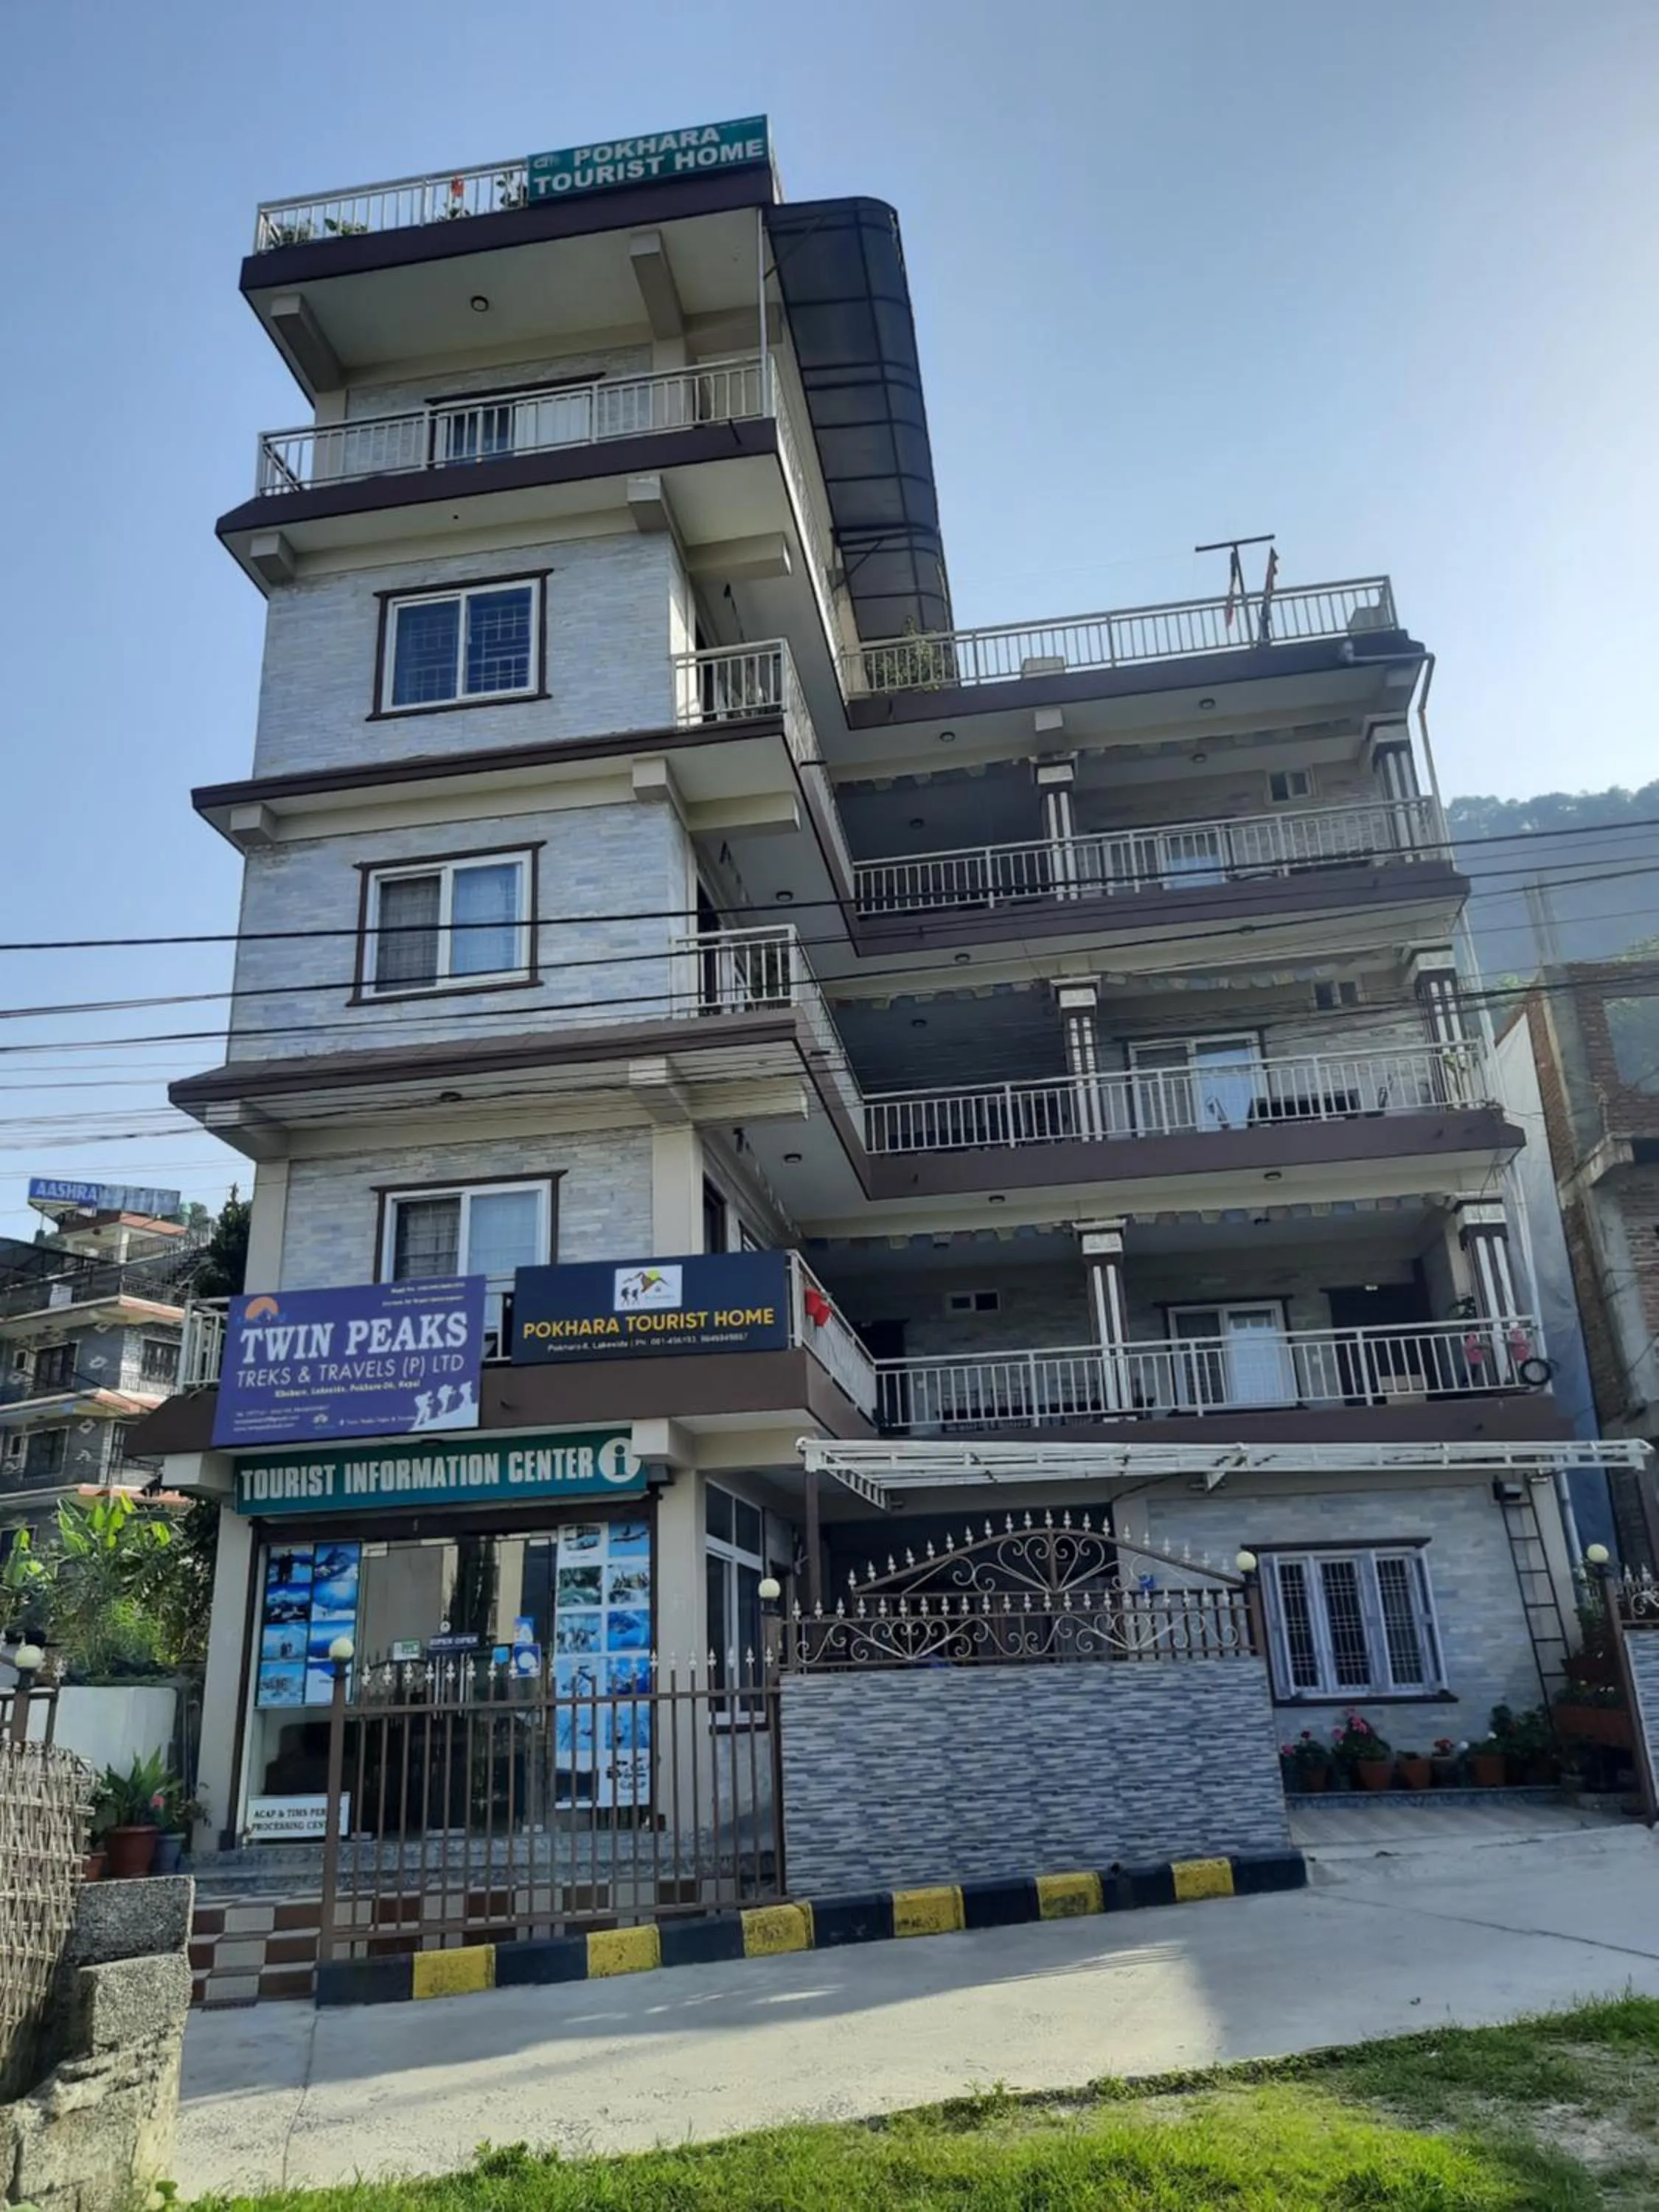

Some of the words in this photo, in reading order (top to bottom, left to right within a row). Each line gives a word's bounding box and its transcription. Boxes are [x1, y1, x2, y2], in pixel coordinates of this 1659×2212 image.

[535, 156, 665, 195] TOURIST
[674, 138, 765, 170] HOME
[573, 126, 720, 167] POKHARA
[240, 1321, 335, 1364] TWIN
[345, 1311, 469, 1356] PEAKS
[523, 1318, 619, 1340] POKHARA
[625, 1311, 708, 1333] TOURIST
[714, 1308, 775, 1326] HOME
[237, 1366, 291, 1388] TREKS
[298, 1368, 310, 1384] &
[319, 1359, 396, 1382] TRAVELS
[403, 1356, 426, 1378] (P)
[432, 1354, 465, 1373] LTD
[241, 1463, 336, 1501] TOURIST
[344, 1453, 500, 1495] INFORMATION
[507, 1446, 594, 1484] CENTER
